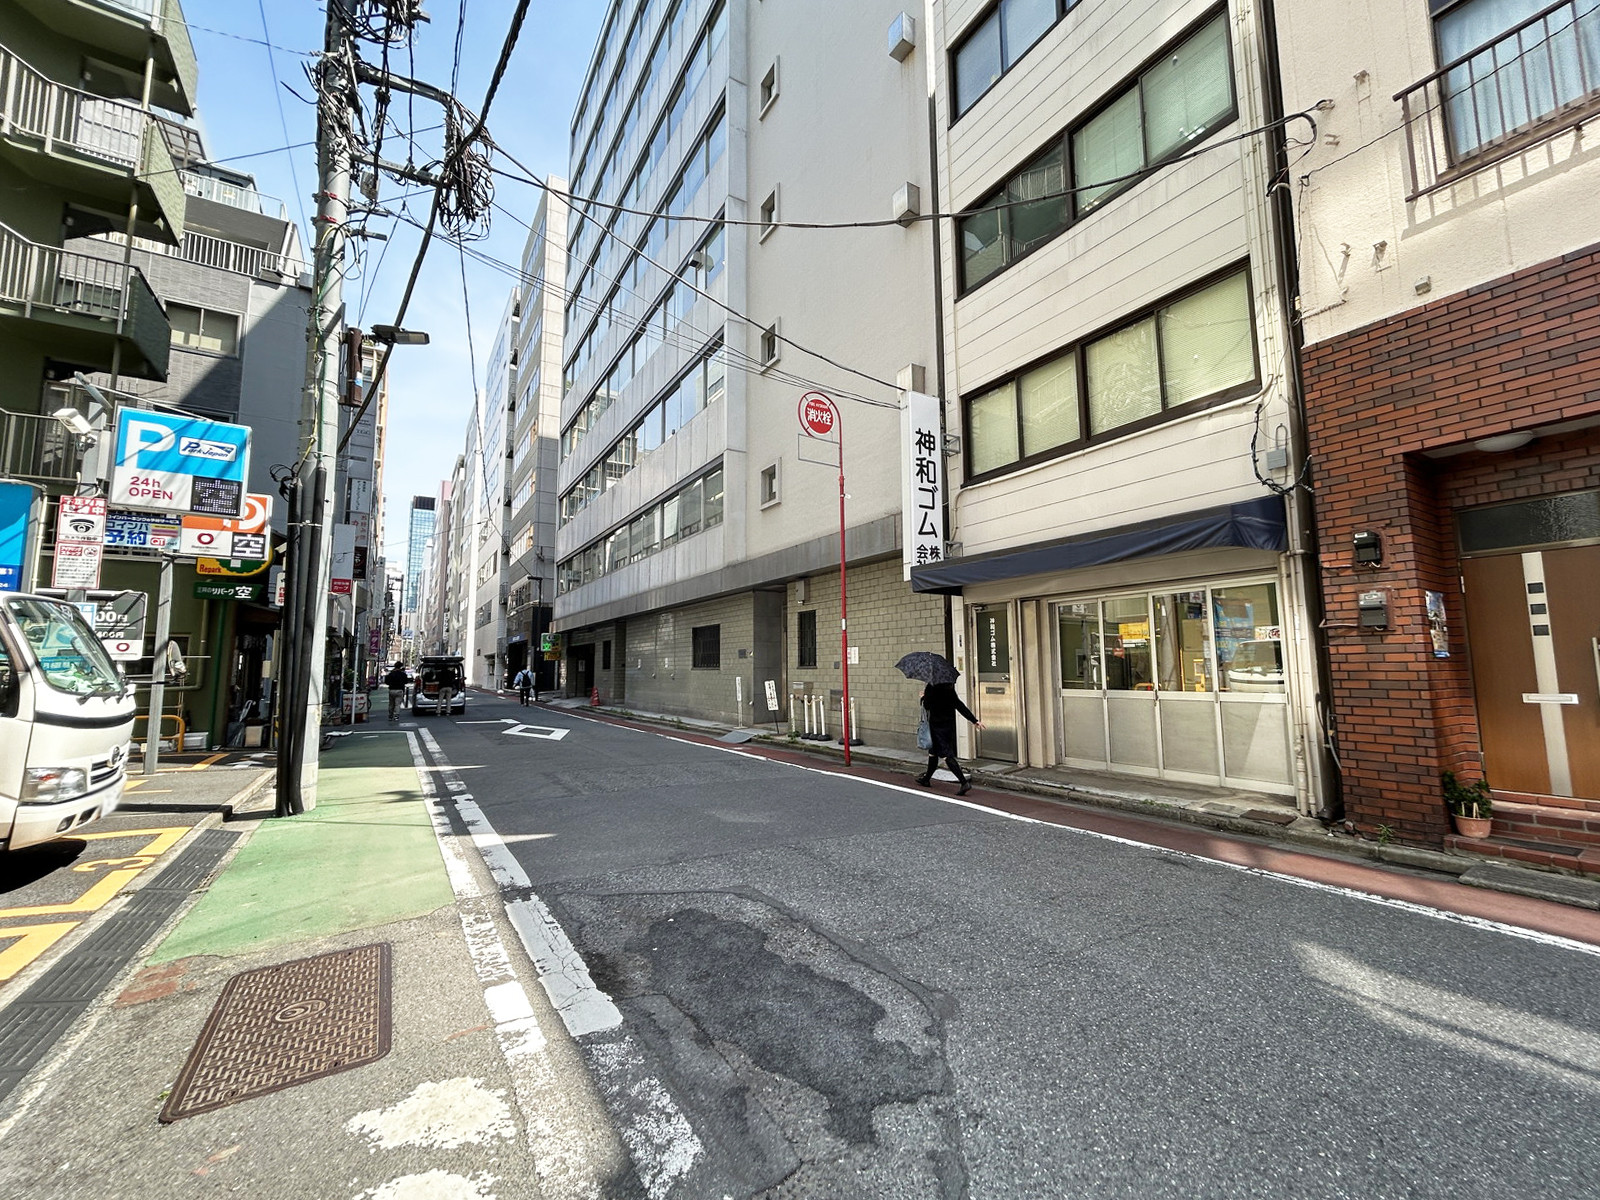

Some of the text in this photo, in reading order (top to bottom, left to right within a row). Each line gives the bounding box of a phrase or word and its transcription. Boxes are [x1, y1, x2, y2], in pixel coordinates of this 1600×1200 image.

[806, 407, 832, 426] 消火栓
[123, 420, 176, 469] P
[130, 476, 161, 488] 24h
[915, 427, 939, 538] 神和ゴム
[128, 487, 173, 501] OPEN
[105, 529, 148, 546] 予約
[233, 534, 265, 558] 空
[200, 564, 222, 574] Repark
[234, 586, 253, 599] 空
